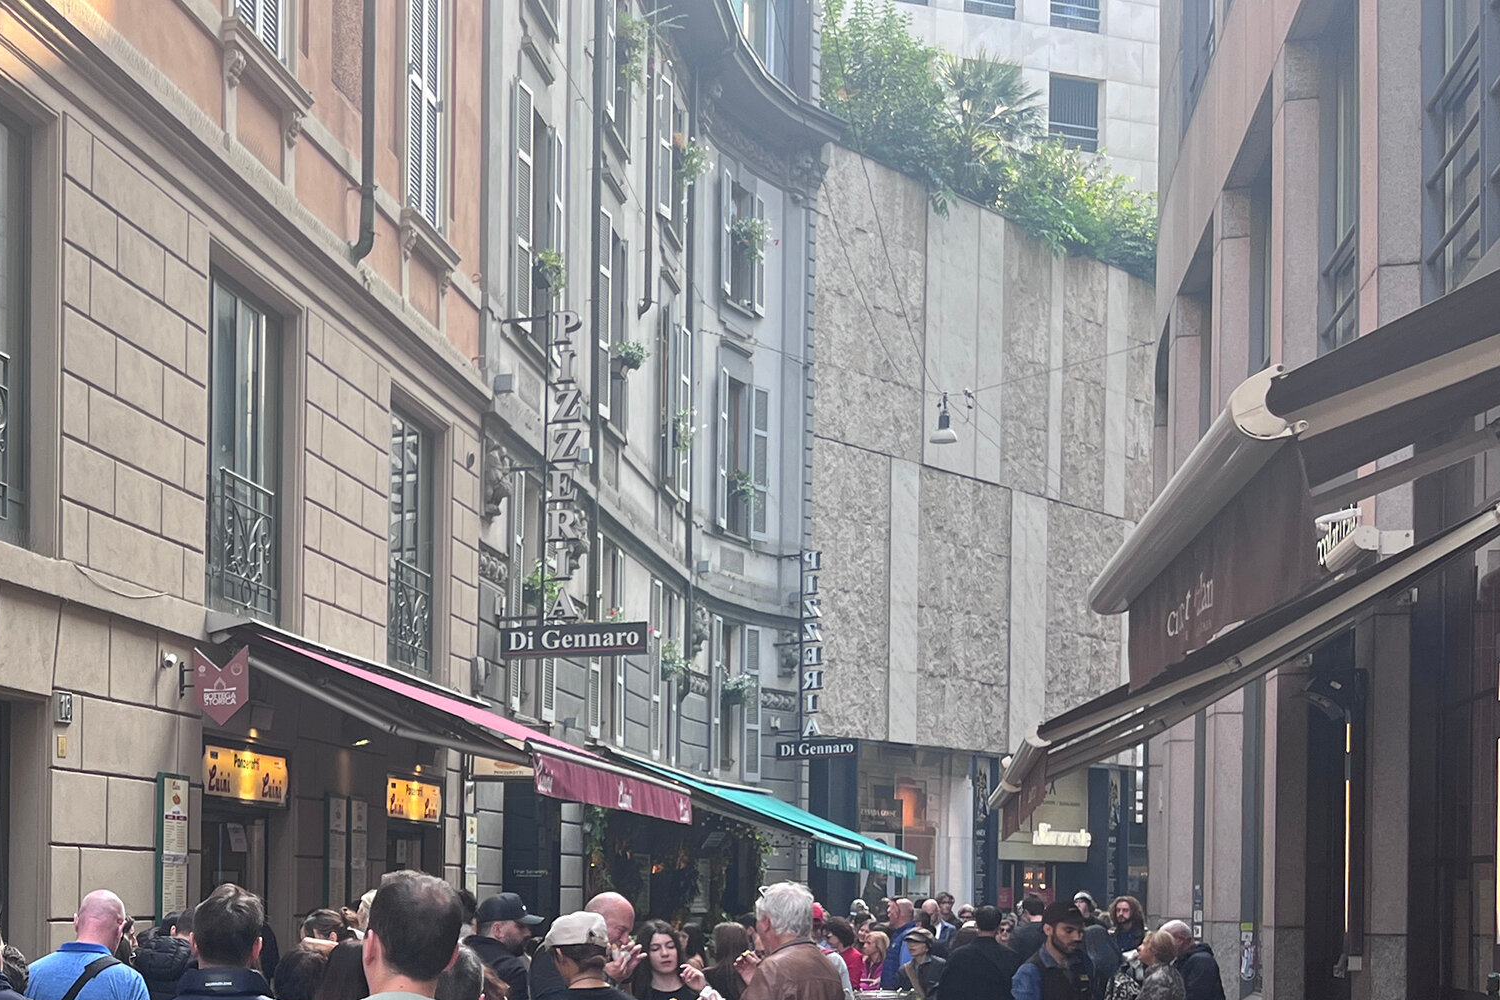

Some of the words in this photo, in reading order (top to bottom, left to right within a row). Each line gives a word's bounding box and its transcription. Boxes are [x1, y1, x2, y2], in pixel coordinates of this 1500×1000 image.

[550, 310, 582, 620] PIZZERIA
[508, 631, 534, 652] Di
[541, 627, 639, 650] Gennaro
[203, 692, 237, 700] BOTTEGA
[203, 698, 237, 706] STORICA
[780, 744, 795, 756] Di
[799, 743, 854, 755] Gennaro
[208, 764, 230, 793] Luini
